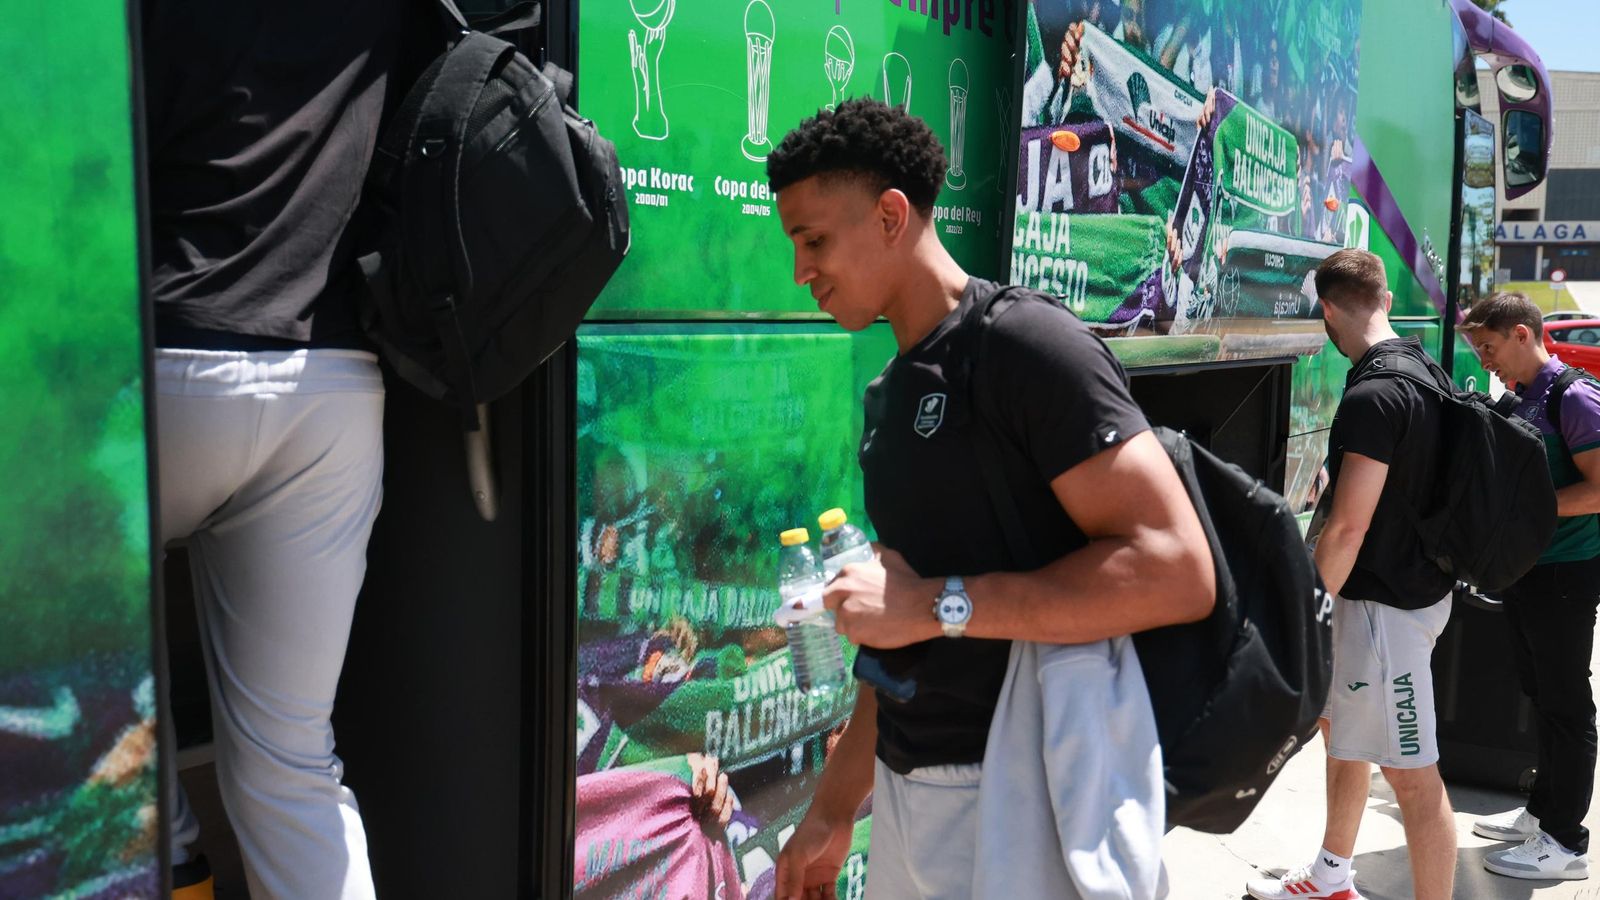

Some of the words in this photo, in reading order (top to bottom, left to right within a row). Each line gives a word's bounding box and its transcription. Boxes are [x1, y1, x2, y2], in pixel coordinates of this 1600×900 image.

[1245, 111, 1287, 174] UNICAJA
[619, 166, 647, 190] opa
[650, 167, 694, 192] Korac
[714, 175, 747, 200] Copa
[750, 180, 770, 200] del
[1232, 147, 1295, 208] BALONCESTO
[635, 193, 668, 207] 2000/01
[741, 203, 771, 216] 2004/05
[932, 205, 949, 222] opa
[950, 205, 965, 221] del
[965, 207, 982, 227] Rey
[1495, 223, 1587, 240] ALAGA
[734, 656, 794, 703] UNIC
[1392, 672, 1421, 756] UNICAJA
